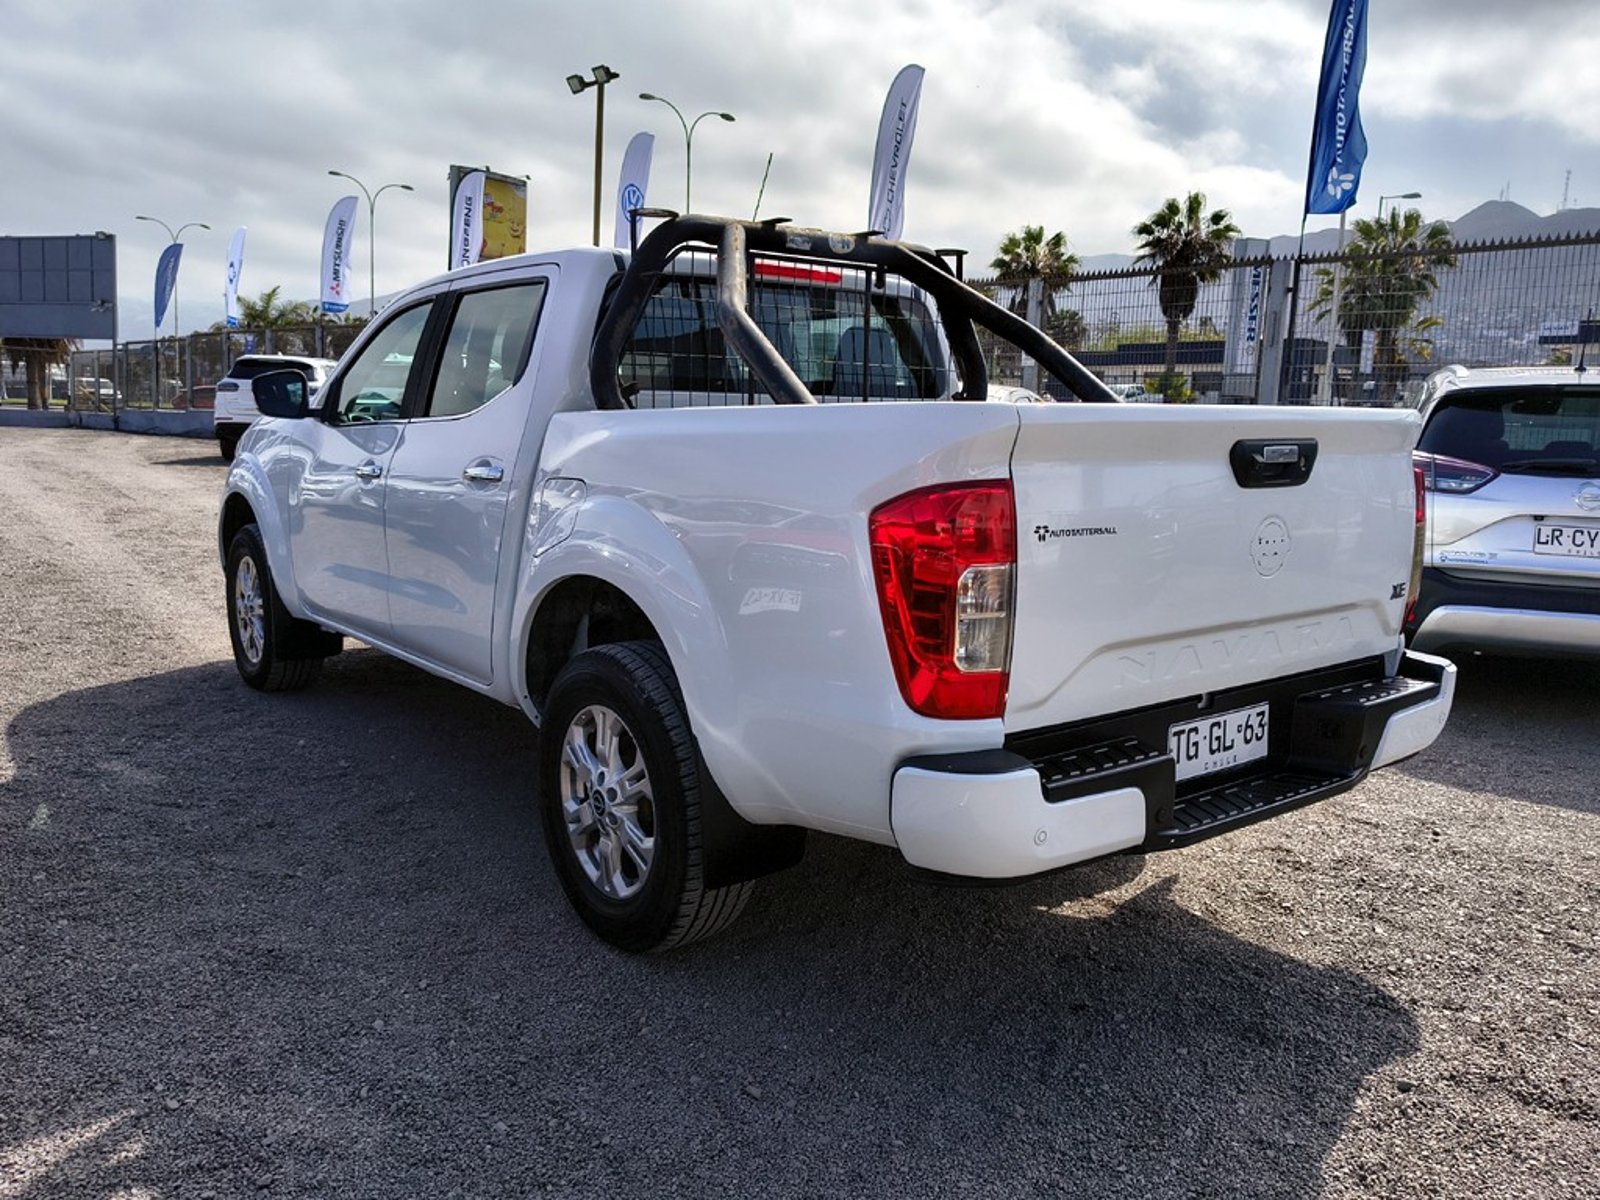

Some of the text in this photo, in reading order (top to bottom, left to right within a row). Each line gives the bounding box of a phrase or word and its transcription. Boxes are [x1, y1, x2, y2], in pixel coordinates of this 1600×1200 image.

[1335, 0, 1355, 163] AUTOTATTERSAL
[886, 97, 908, 204] CHEVROLET
[332, 219, 346, 281] MITSUBISHI
[1389, 582, 1406, 600] XE
[1115, 616, 1356, 689] NAVARA
